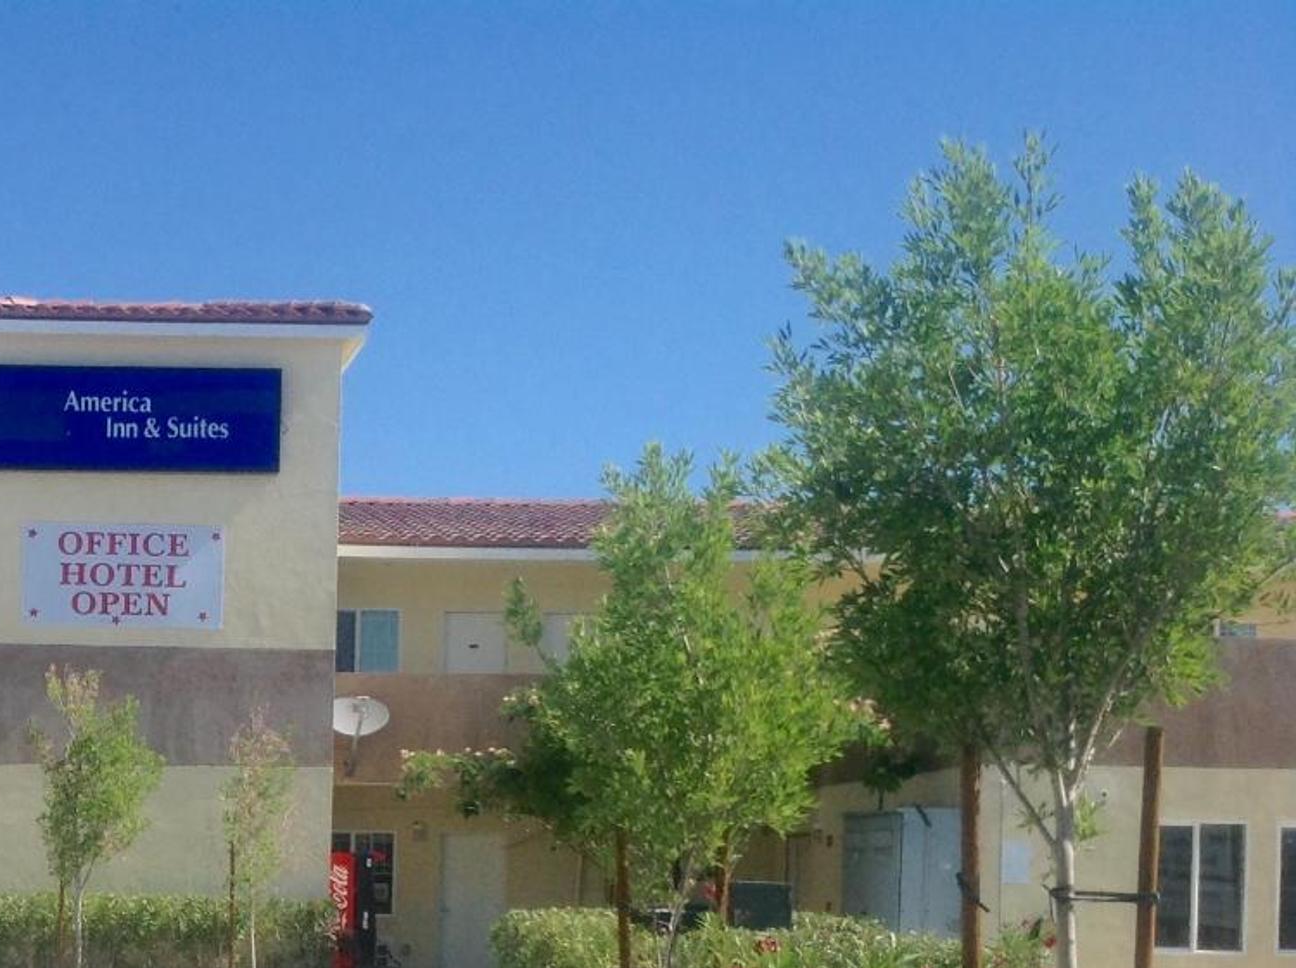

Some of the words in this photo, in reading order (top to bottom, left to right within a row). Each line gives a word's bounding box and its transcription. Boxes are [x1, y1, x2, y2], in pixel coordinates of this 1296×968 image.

[64, 390, 152, 413] America
[106, 417, 139, 438] Inn
[143, 418, 161, 438] &
[167, 416, 229, 438] Suites
[57, 531, 190, 557] OFFICE
[59, 562, 187, 588] HOTEL
[70, 591, 171, 616] OPEN
